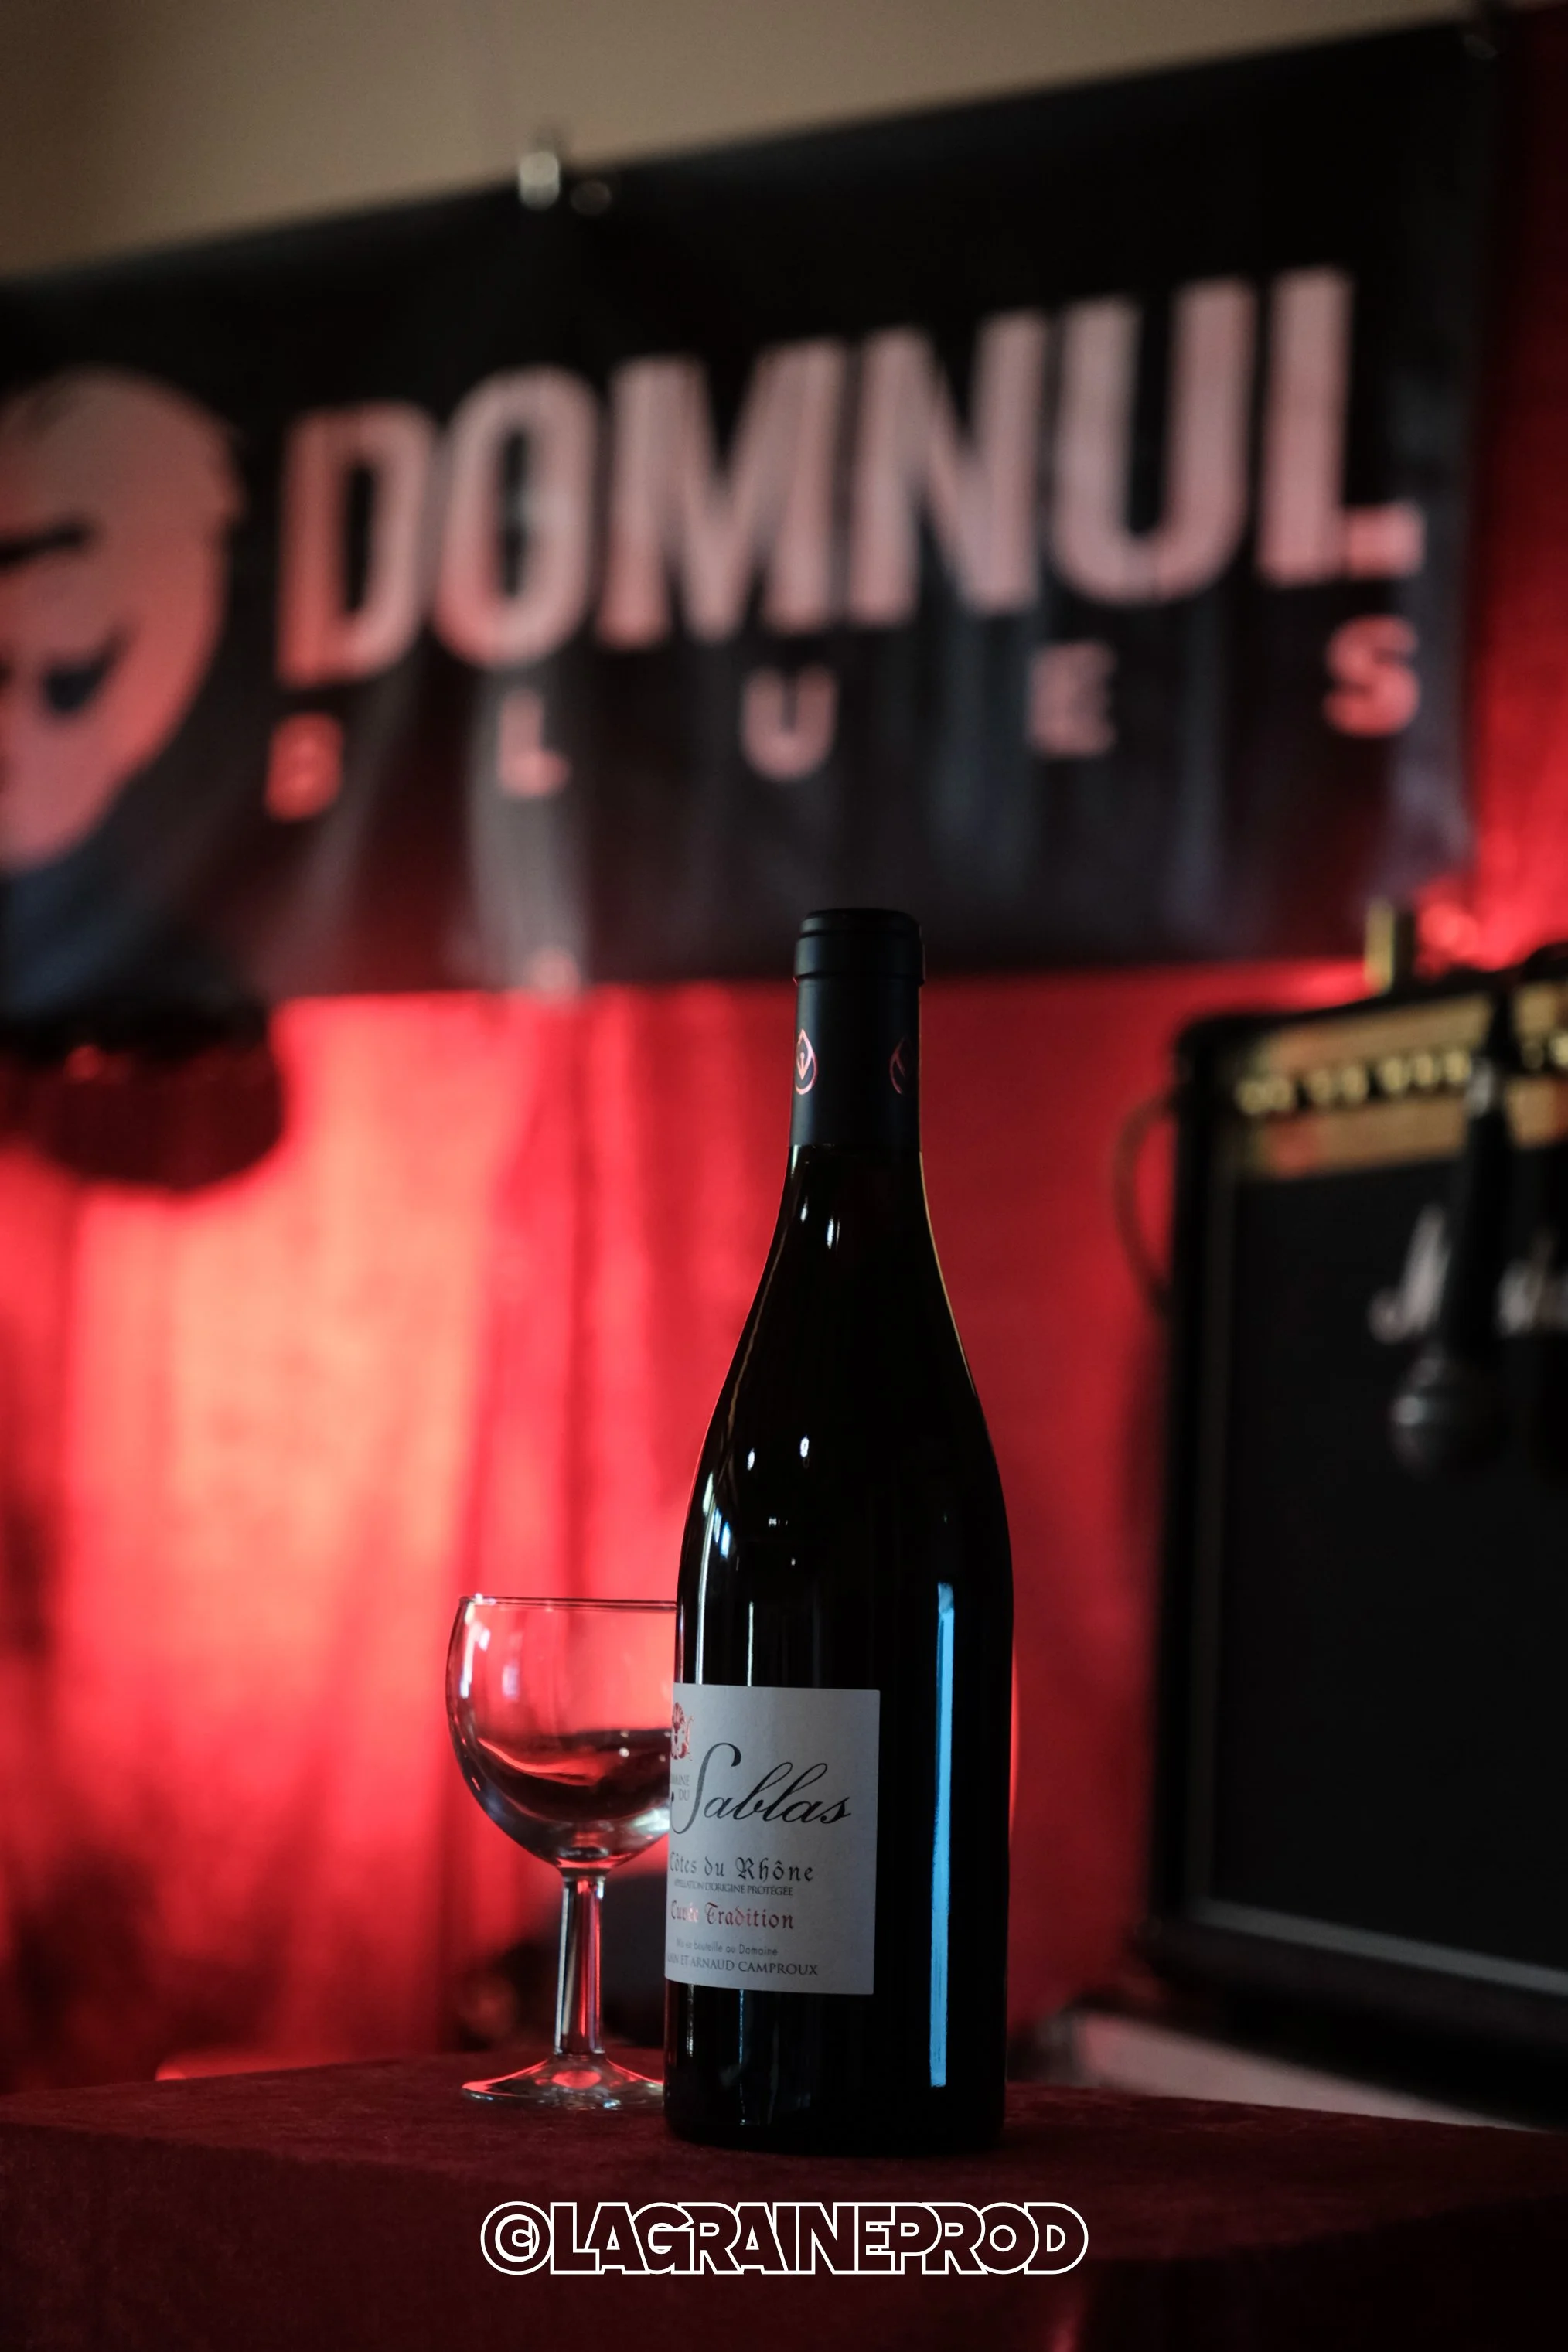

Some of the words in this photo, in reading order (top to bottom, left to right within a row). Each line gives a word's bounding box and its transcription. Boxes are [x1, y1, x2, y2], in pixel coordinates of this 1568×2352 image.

[277, 264, 1424, 688] DOMNUL
[670, 1742, 851, 1834] Sablas
[670, 1851, 697, 1874] Côtes
[704, 1855, 724, 1877] du
[735, 1856, 815, 1883] Rhône
[704, 1901, 795, 1930] Tradition
[726, 1945, 735, 1954] au
[738, 1942, 779, 1957] Domaine
[690, 1956, 735, 1972] ARNAUD
[738, 1961, 820, 1976] CAMPROUX
